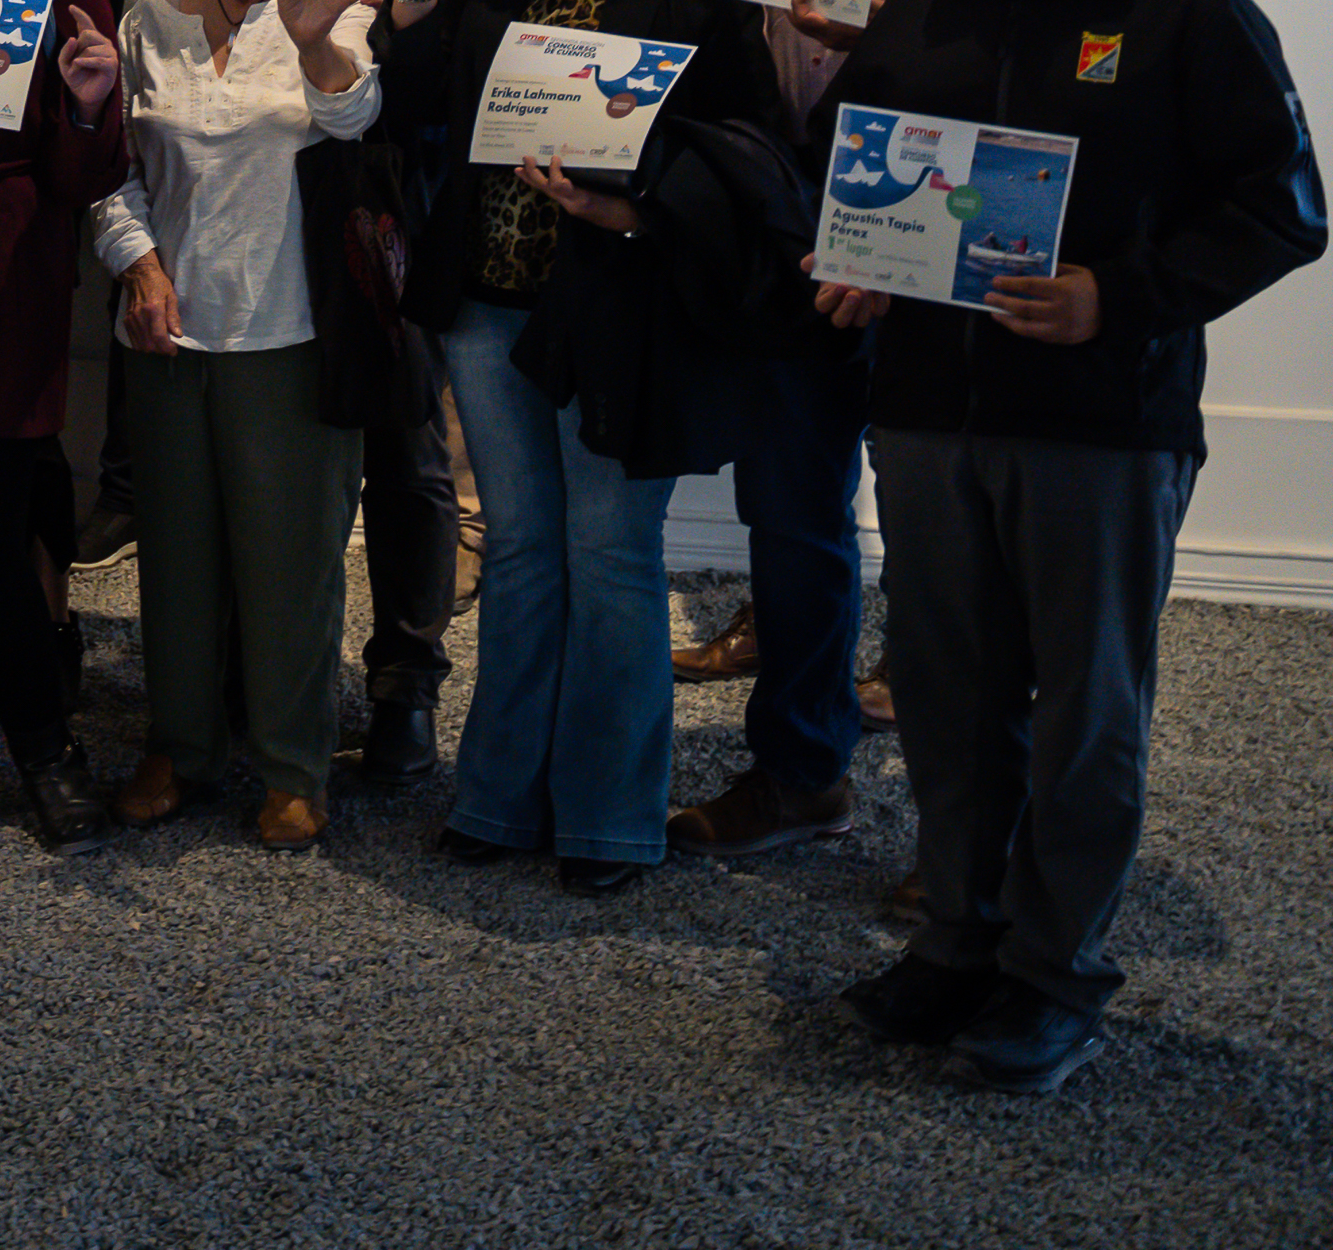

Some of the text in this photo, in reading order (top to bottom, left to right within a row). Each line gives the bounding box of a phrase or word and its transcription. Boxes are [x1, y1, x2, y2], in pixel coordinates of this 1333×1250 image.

[520, 33, 550, 42] amar
[547, 42, 597, 53] CONCURSO
[556, 49, 597, 59] CUENTOS
[491, 87, 581, 102] Erika Lahmann
[487, 101, 549, 117] Rodríguez
[904, 125, 944, 139] amar
[832, 208, 926, 234] Agustín Tapia
[830, 222, 868, 240] Pérez
[846, 239, 873, 258] lugar
